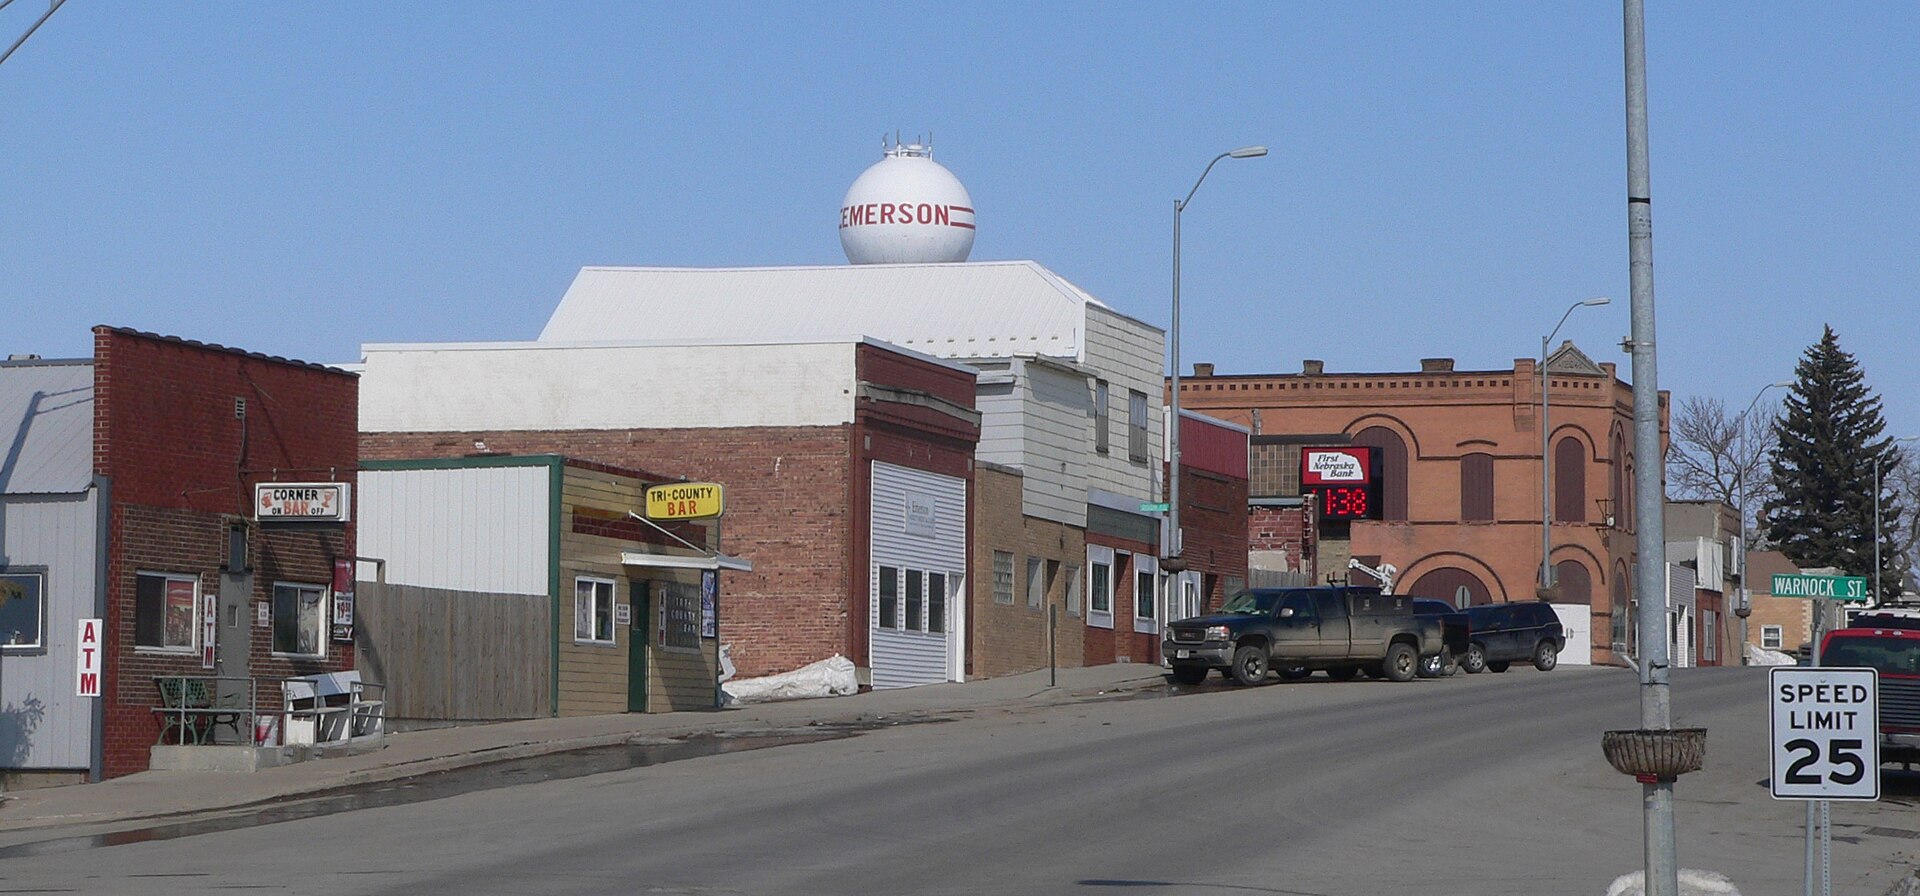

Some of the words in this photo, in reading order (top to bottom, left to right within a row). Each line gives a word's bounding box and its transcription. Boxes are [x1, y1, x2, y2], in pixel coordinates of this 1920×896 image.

[842, 203, 949, 229] EMERSON
[1313, 462, 1355, 470] Nebraska
[1317, 454, 1339, 462] First
[1330, 470, 1354, 478] Bank
[273, 489, 319, 501] CORNER
[651, 487, 713, 502] TRI-COUNTY
[1326, 488, 1367, 515] 1:38
[283, 501, 309, 515] BAR
[311, 507, 324, 515] OFF
[667, 500, 697, 516] BAR
[1774, 577, 1835, 597] WARNOCK
[1847, 580, 1862, 597] ST
[205, 597, 213, 667] ATM
[81, 622, 97, 694] ATM
[1780, 684, 1868, 703] SPEED
[1790, 711, 1858, 730] LIMIT
[1784, 738, 1865, 785] 25
